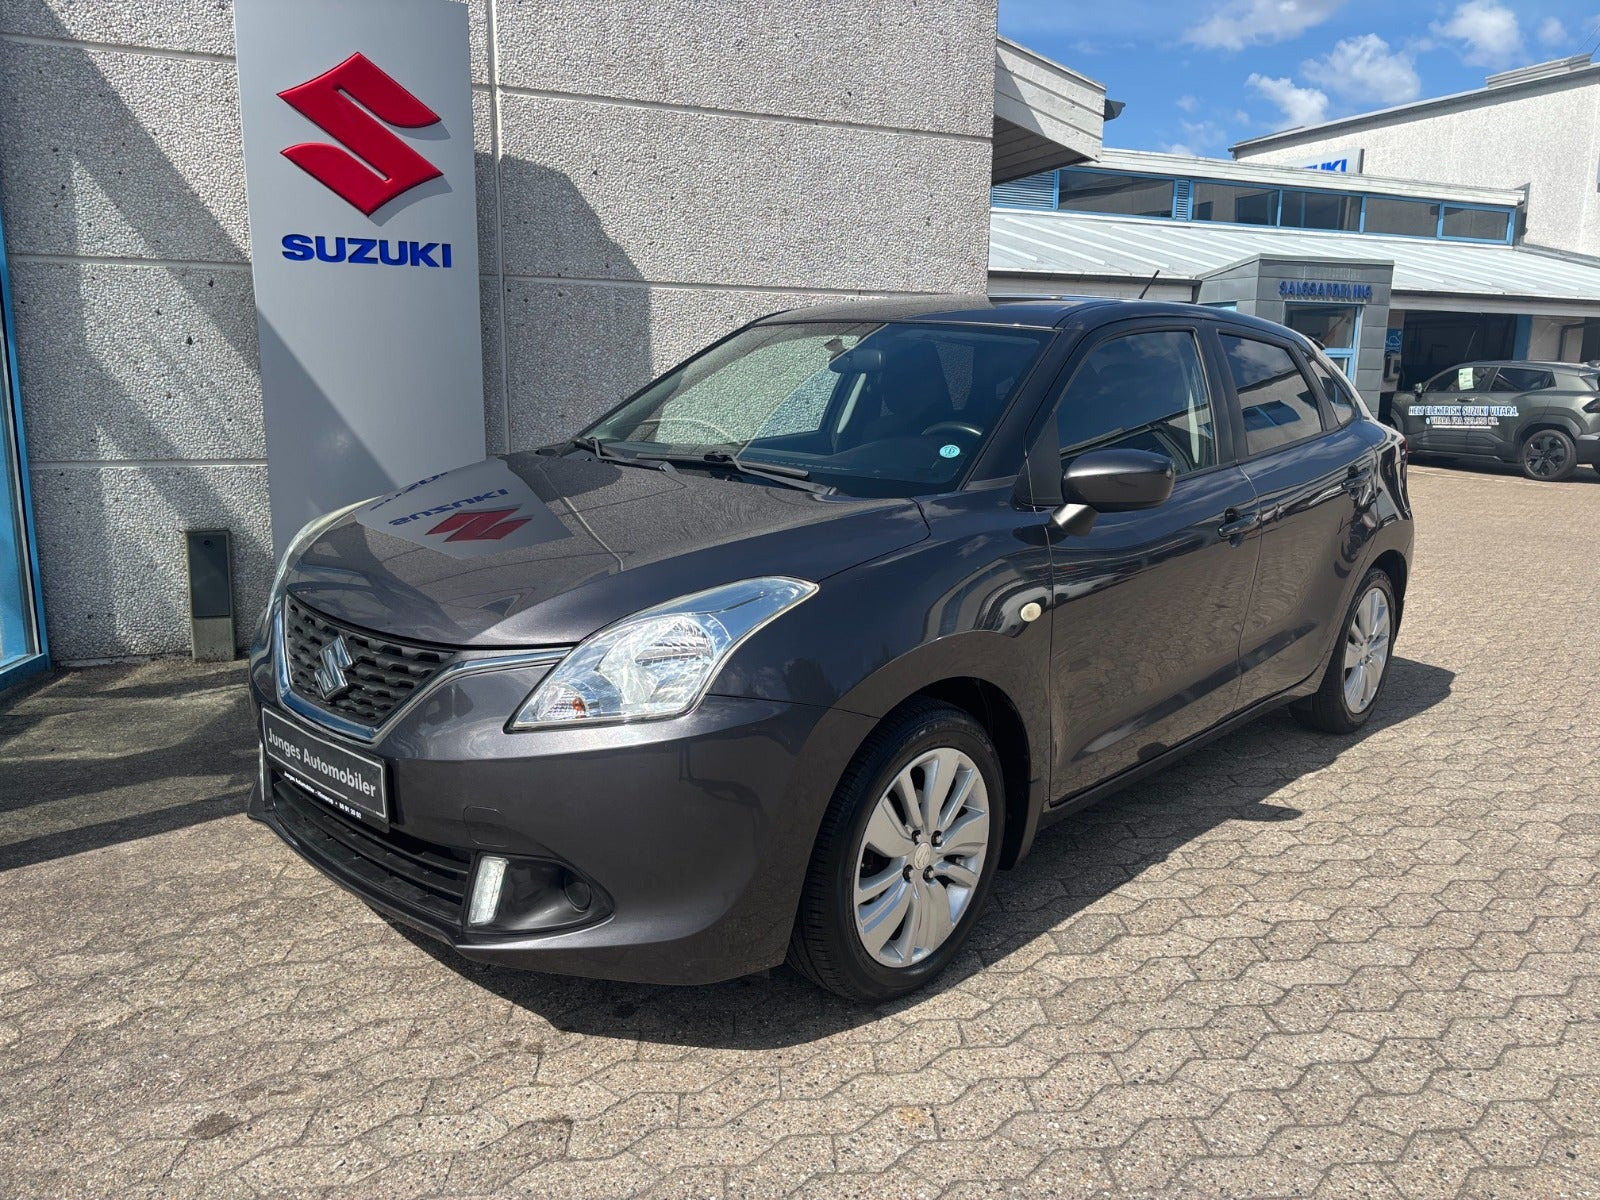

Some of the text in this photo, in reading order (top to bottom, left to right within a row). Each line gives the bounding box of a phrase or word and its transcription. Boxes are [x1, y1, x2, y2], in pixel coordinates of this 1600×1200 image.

[282, 234, 452, 268] SUZUKI
[1408, 405, 1425, 415] HELT
[1425, 405, 1461, 416] ELEKTRISK
[1462, 405, 1489, 416] SUZUKI
[268, 728, 376, 797] Junges Automobiler
